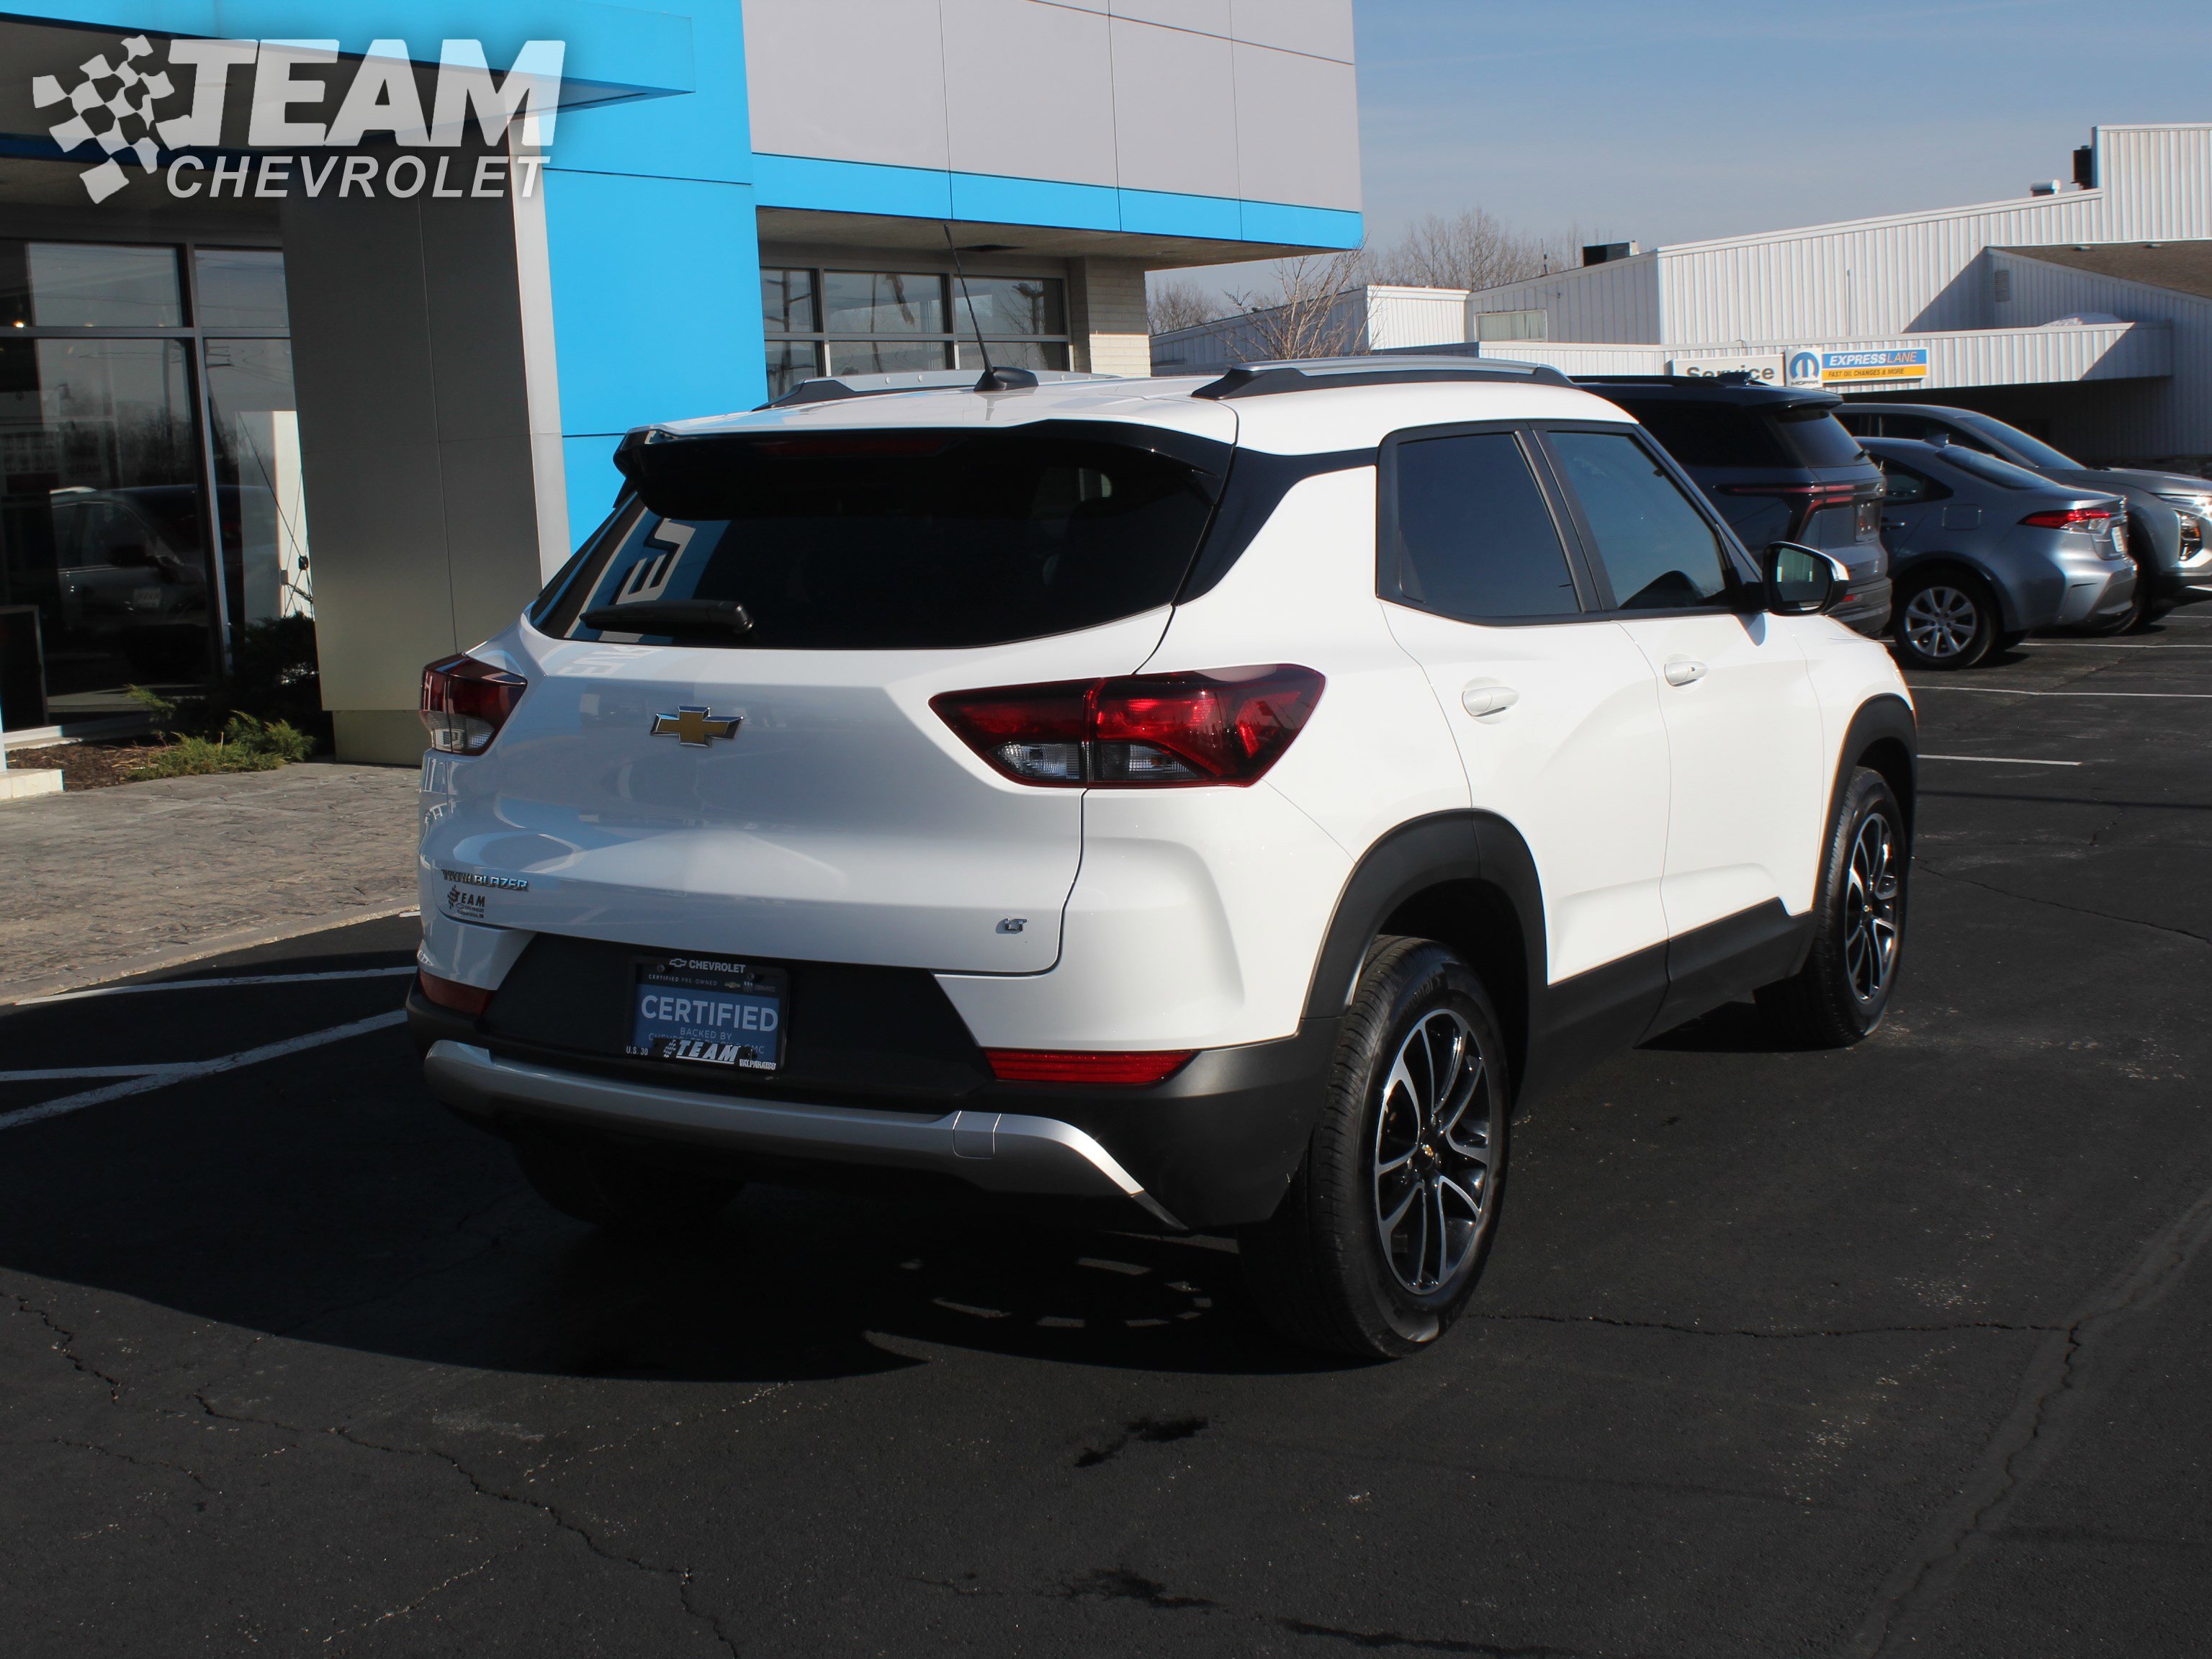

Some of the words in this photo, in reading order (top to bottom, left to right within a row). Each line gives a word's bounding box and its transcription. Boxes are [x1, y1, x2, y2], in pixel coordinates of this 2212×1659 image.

[1686, 365, 1774, 380] Seice
[454, 891, 485, 907] TEAM
[688, 960, 746, 973] CHEVROLET
[641, 995, 778, 1032] CERTIFIED
[680, 1028, 716, 1039] BACKED
[720, 1032, 732, 1040] BY
[676, 1040, 740, 1062] TEAM
[739, 1058, 777, 1071] VALPARAISO
